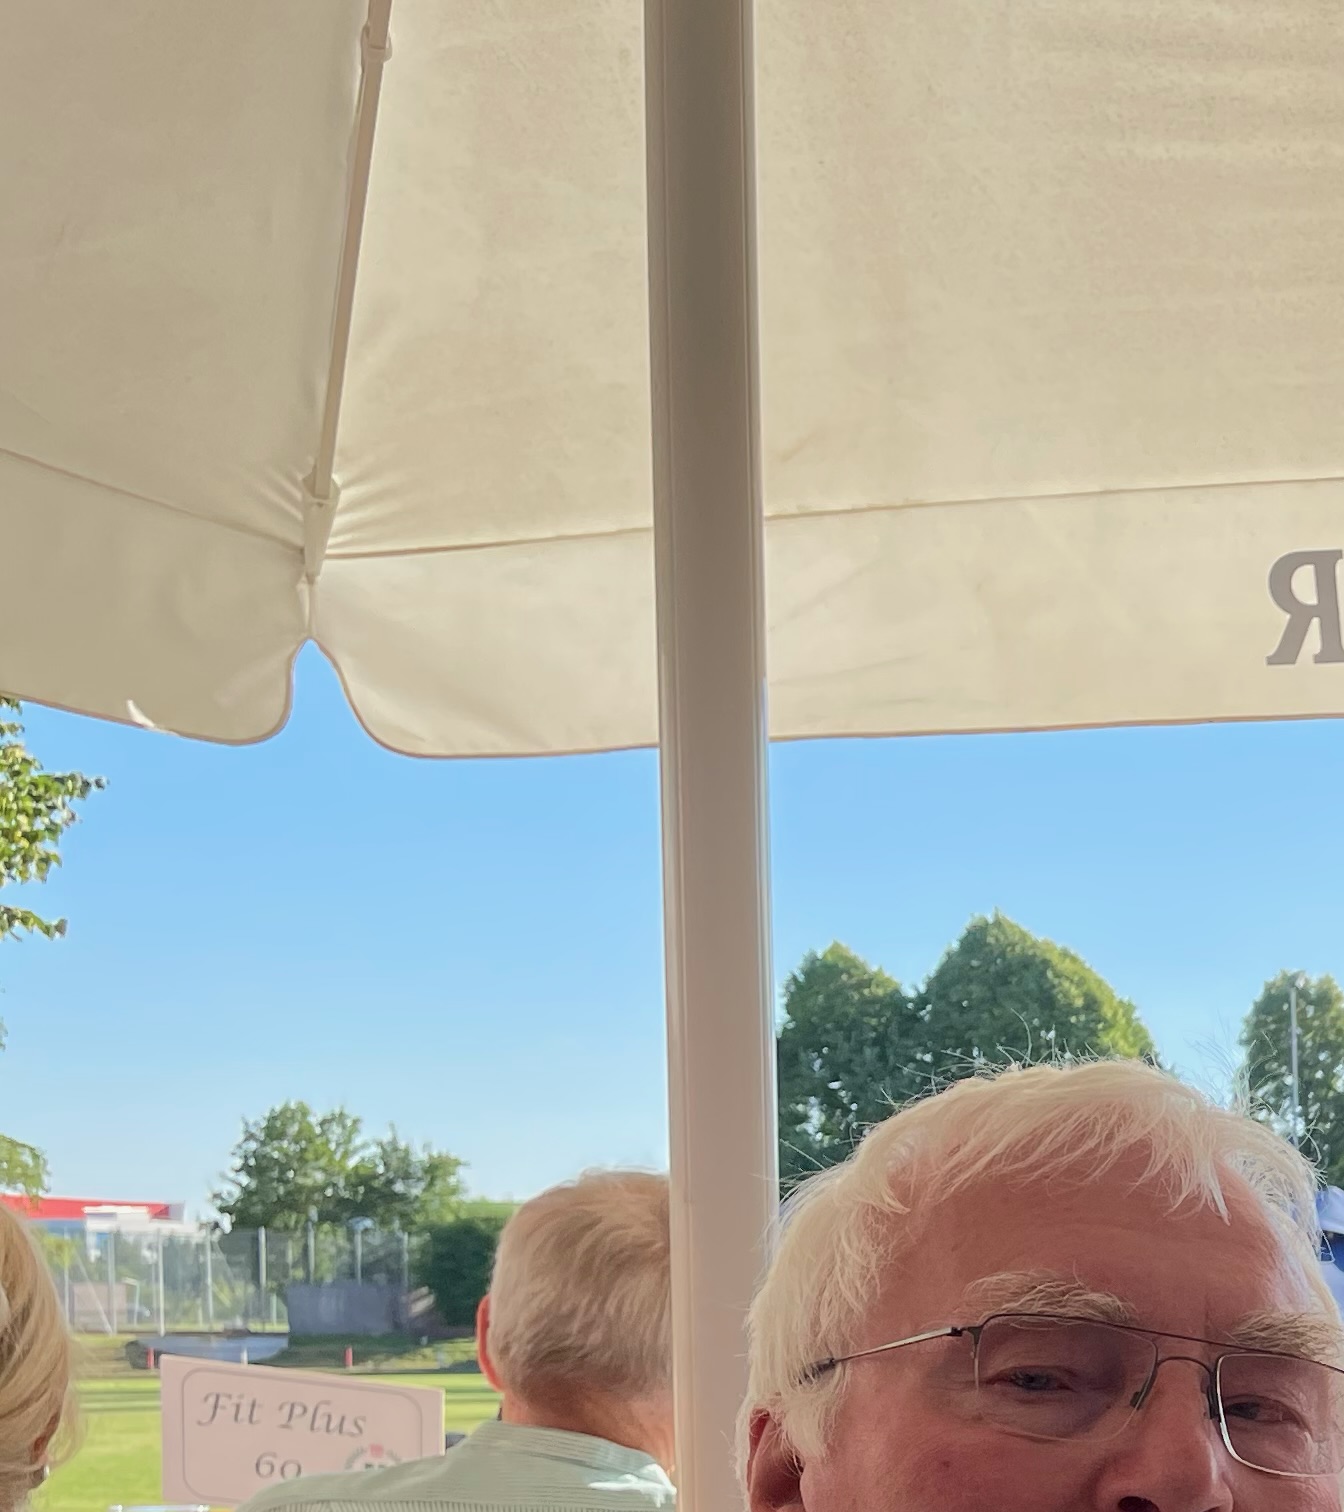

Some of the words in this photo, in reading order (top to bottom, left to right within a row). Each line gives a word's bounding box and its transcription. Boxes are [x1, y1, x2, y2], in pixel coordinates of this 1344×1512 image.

[196, 1391, 263, 1427] Fit
[277, 1400, 368, 1438] Plus
[255, 1452, 302, 1480] 60
